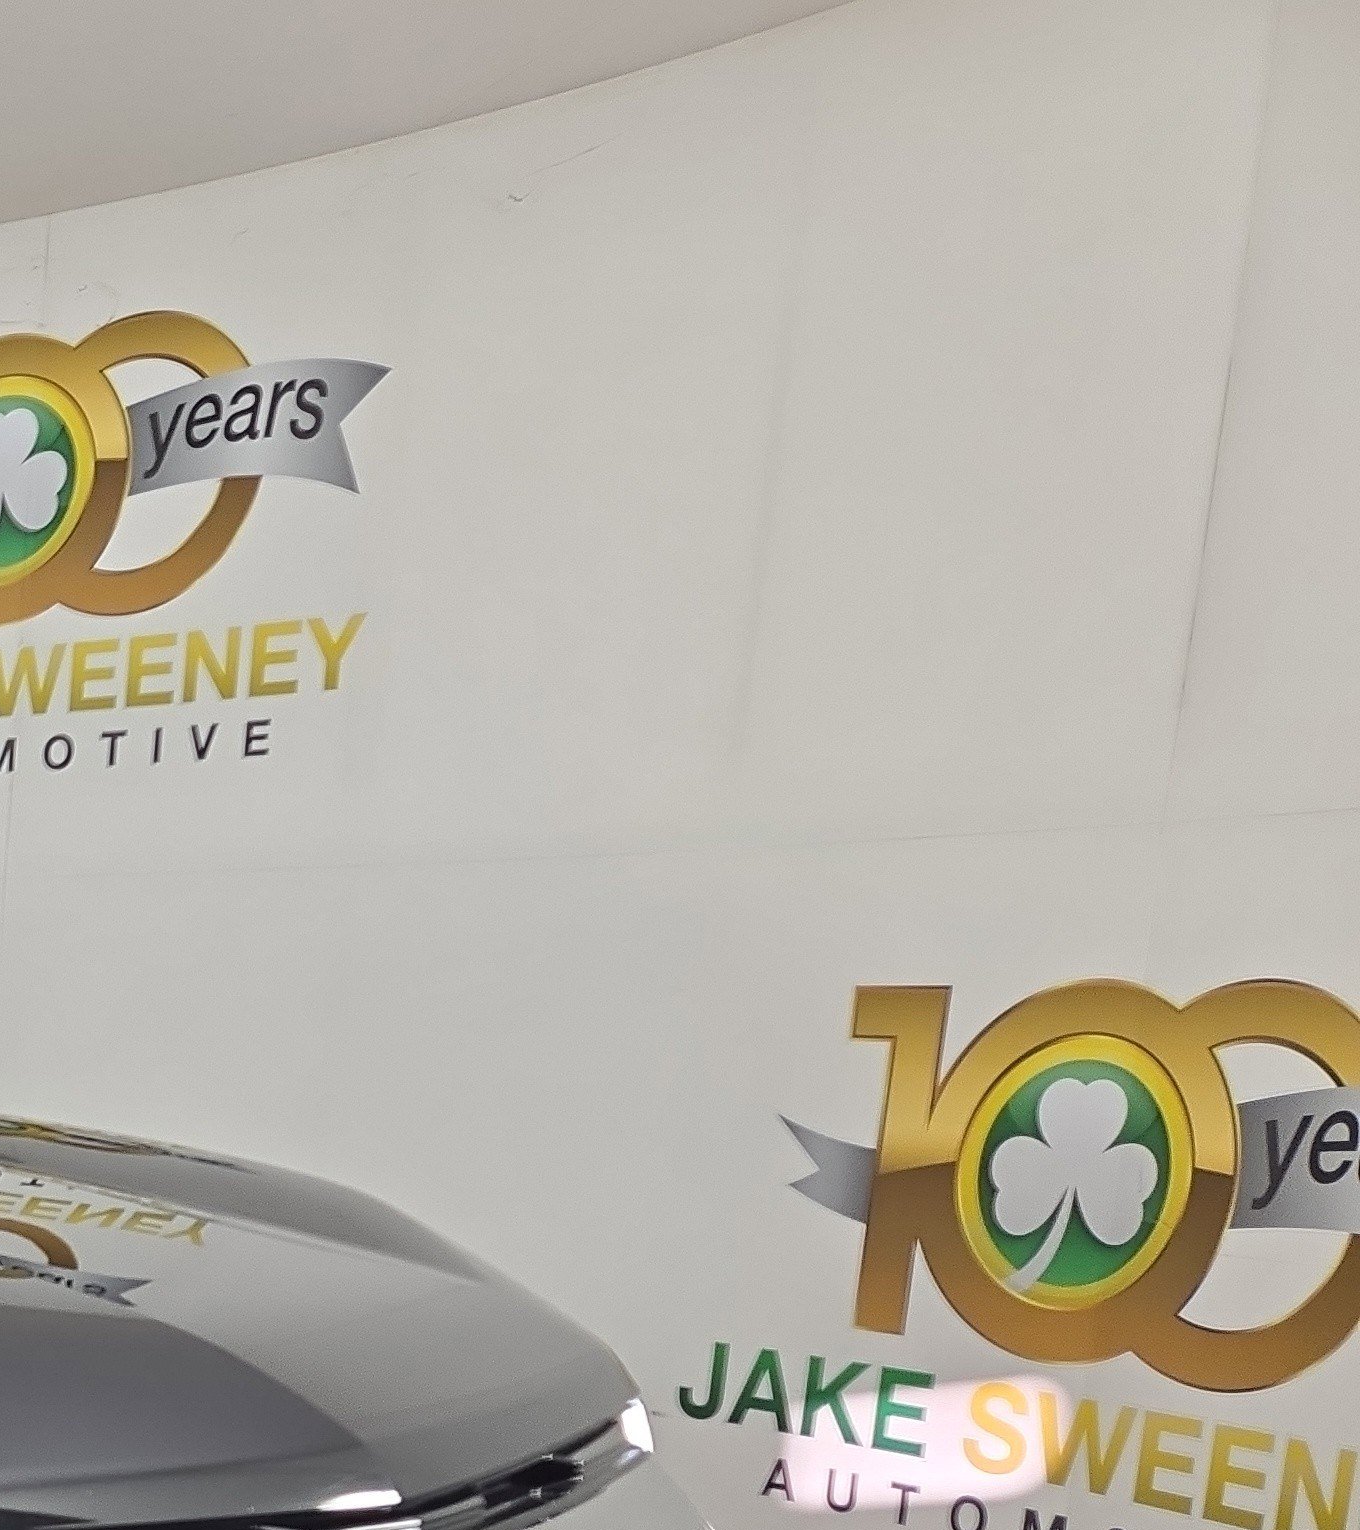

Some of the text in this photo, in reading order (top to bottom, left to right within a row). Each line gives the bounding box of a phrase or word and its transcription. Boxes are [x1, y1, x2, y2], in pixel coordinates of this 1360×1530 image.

[143, 375, 329, 480] years
[1251, 1110, 1360, 1211] ye
[678, 1340, 936, 1459] JAKE
